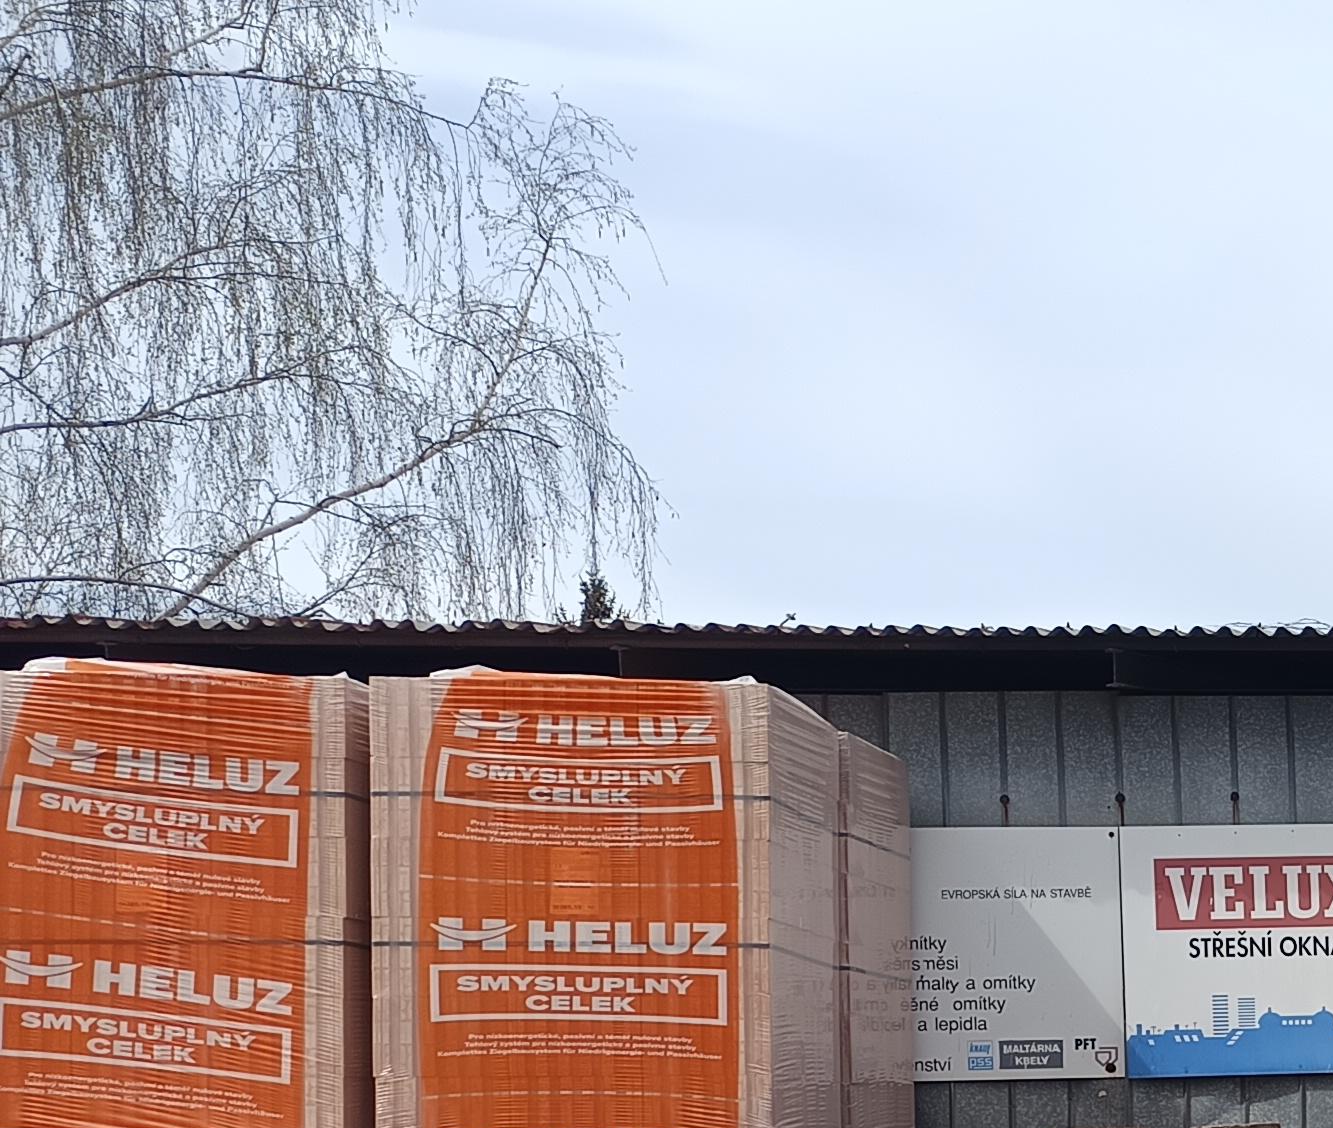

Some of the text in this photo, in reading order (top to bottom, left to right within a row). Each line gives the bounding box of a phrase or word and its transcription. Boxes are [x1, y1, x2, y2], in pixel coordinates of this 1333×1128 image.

[535, 713, 717, 747] HELUZ
[116, 745, 299, 796] HELUZ
[465, 762, 687, 787] SMYSLUPLNÝ
[528, 785, 633, 806] CELEK
[39, 792, 265, 835] SMYSLUPLNÝ
[102, 823, 209, 850] CELEK
[941, 887, 1092, 899] EVROPSKÁ SÍLA NA STAVBĚ
[528, 920, 727, 955] HELUZ
[1189, 930, 1272, 959] STŘEŠNÍ
[92, 959, 293, 1015] HELUZ
[456, 974, 694, 996] SMYSLUPLNÝ
[966, 979, 975, 990] a
[983, 974, 1036, 993] omítky
[525, 995, 636, 1013] CELEK
[953, 996, 1006, 1014] omítky
[20, 1010, 256, 1052] SMYSLUPLNÝ
[918, 1017, 988, 1034] a lepidla
[86, 1038, 197, 1064] CELEK
[1003, 1043, 1061, 1054] MALTÁRNA
[1074, 1038, 1097, 1050] PFT
[1015, 1055, 1050, 1066] KBELY
